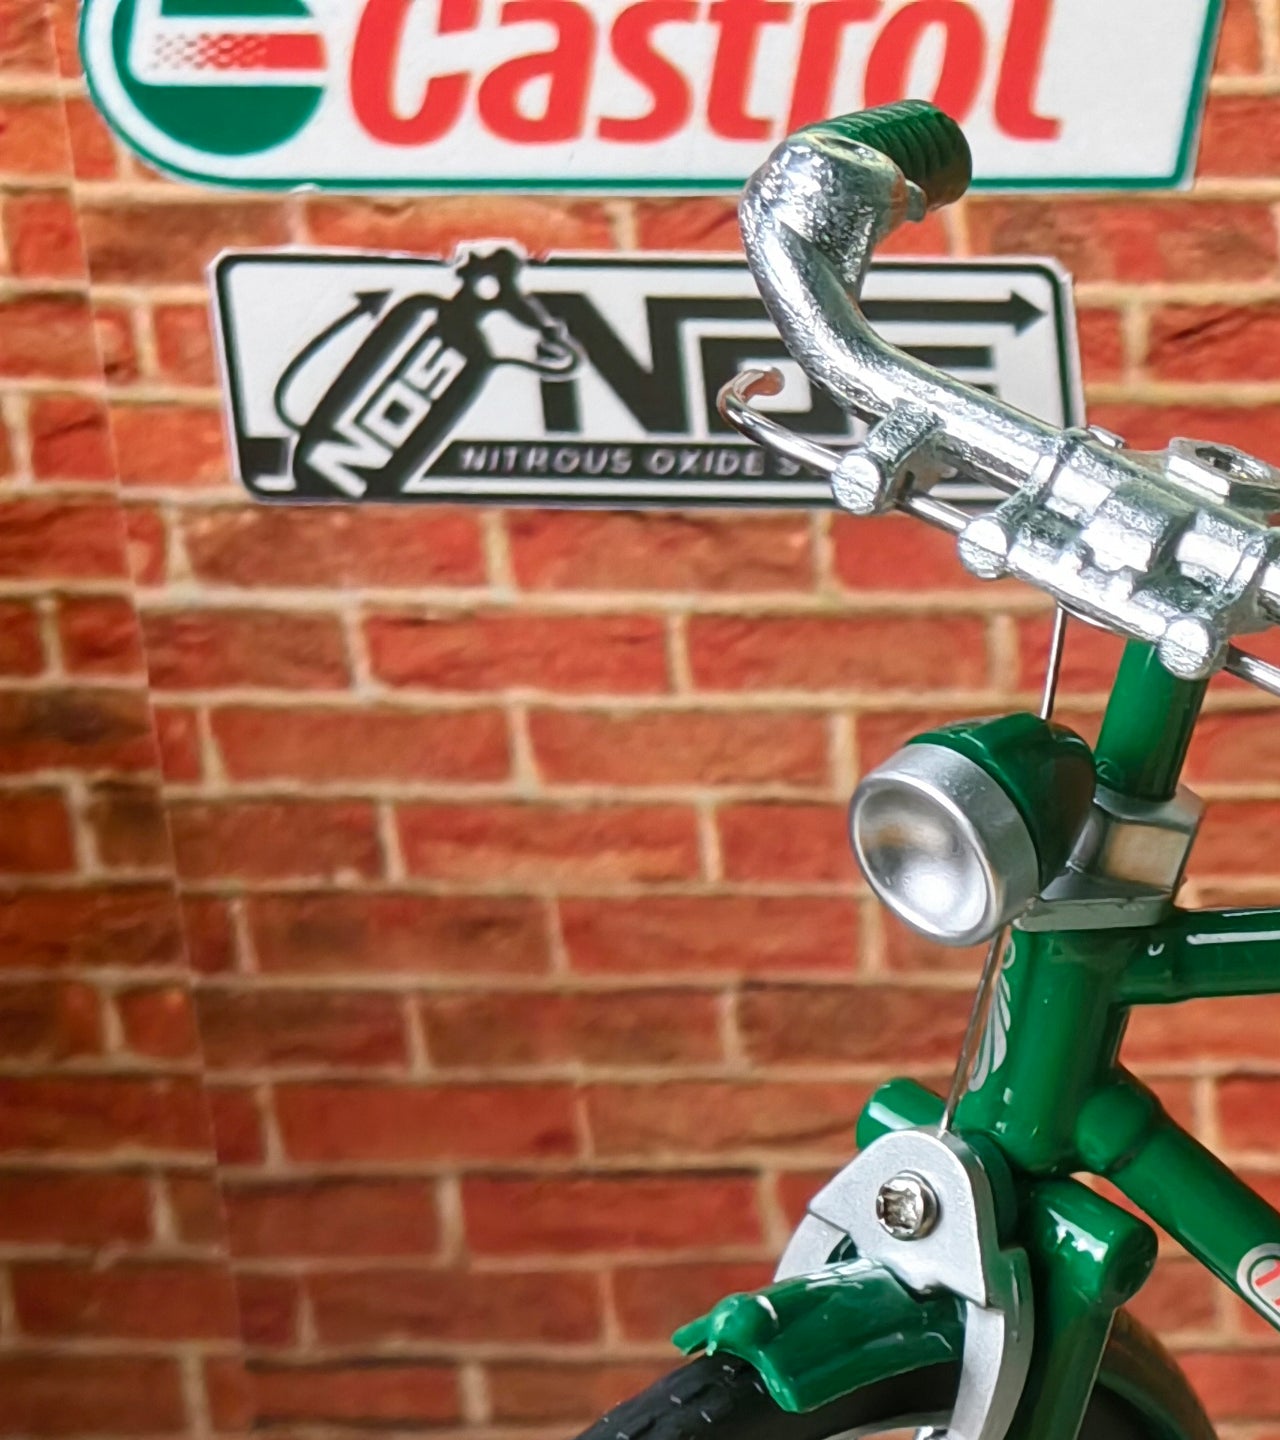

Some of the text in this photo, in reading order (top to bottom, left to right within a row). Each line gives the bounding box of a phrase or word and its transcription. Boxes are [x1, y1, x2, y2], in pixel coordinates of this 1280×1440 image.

[347, 0, 1061, 147] Castrol
[306, 308, 468, 498] NOS
[527, 290, 1046, 437] NO
[461, 446, 633, 475] NITROUS
[651, 448, 765, 476] OXIDE
